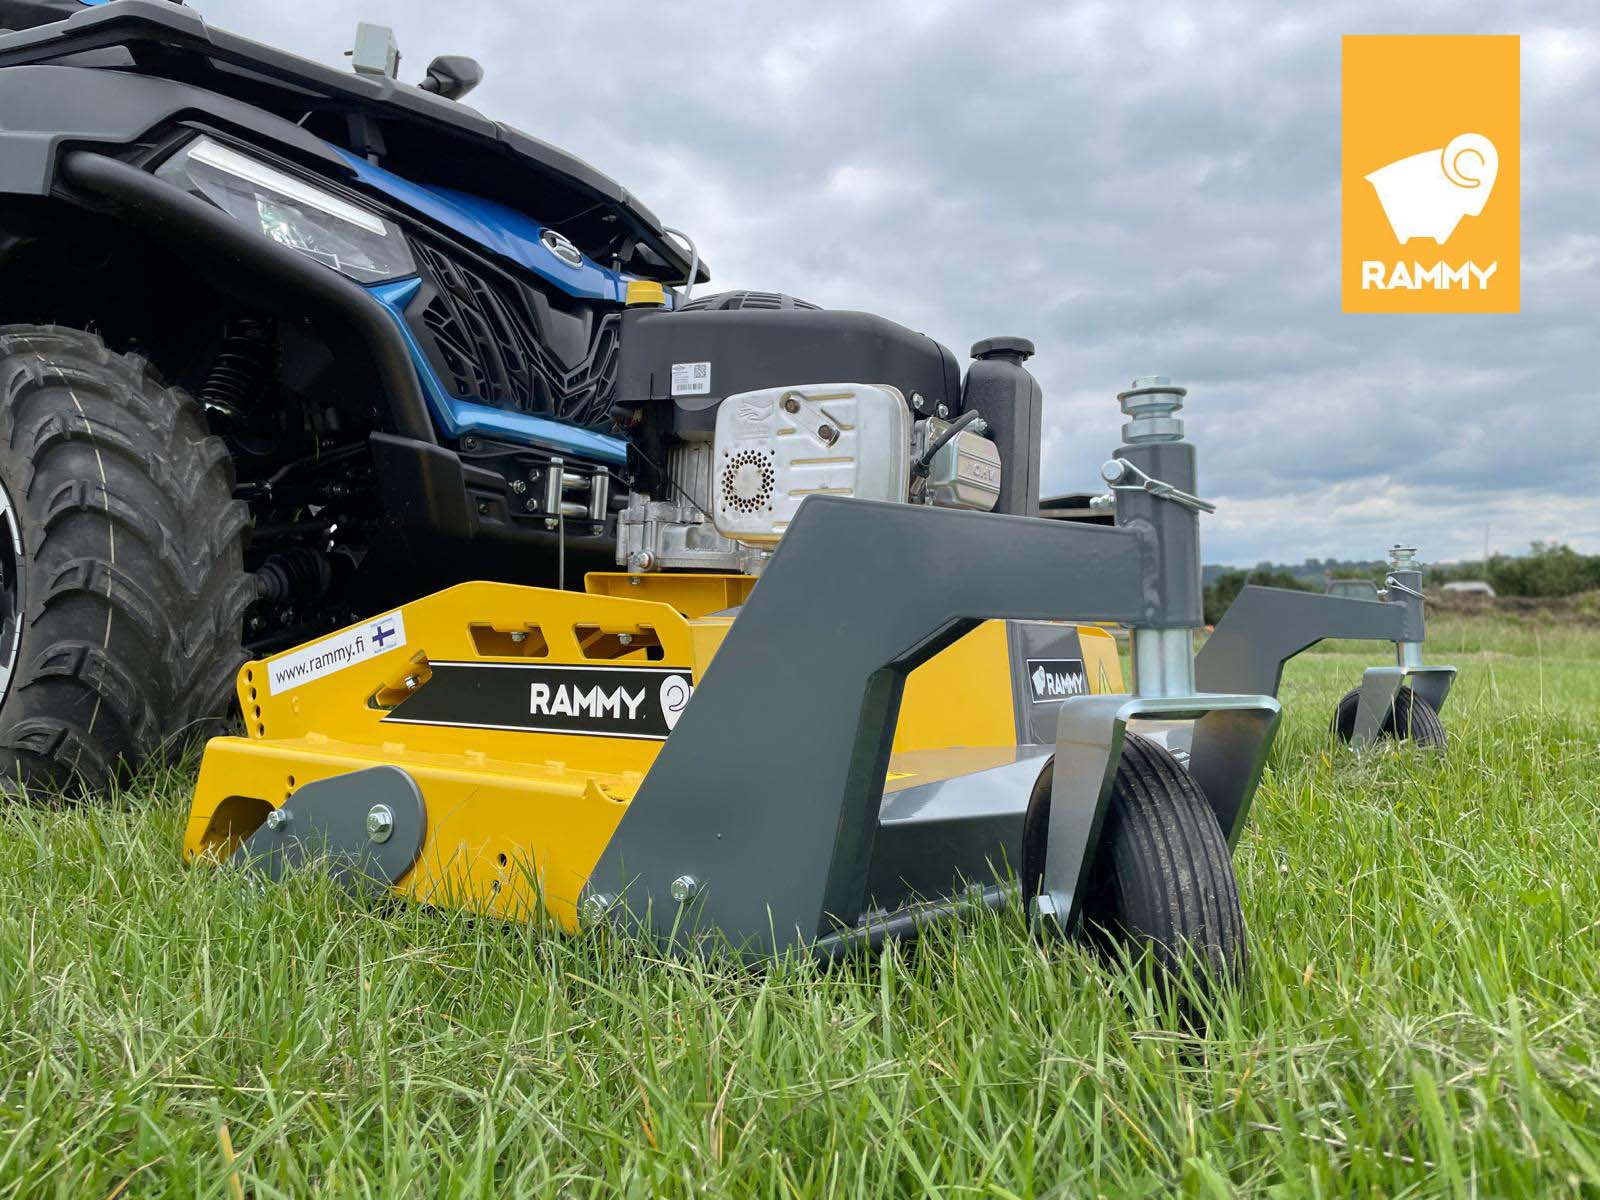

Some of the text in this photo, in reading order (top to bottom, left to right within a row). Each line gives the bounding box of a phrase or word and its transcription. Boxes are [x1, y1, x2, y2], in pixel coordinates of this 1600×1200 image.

[275, 636, 365, 684] www.rammy.fi
[530, 682, 646, 720] RAMMY
[1046, 672, 1082, 695] RAMMY
